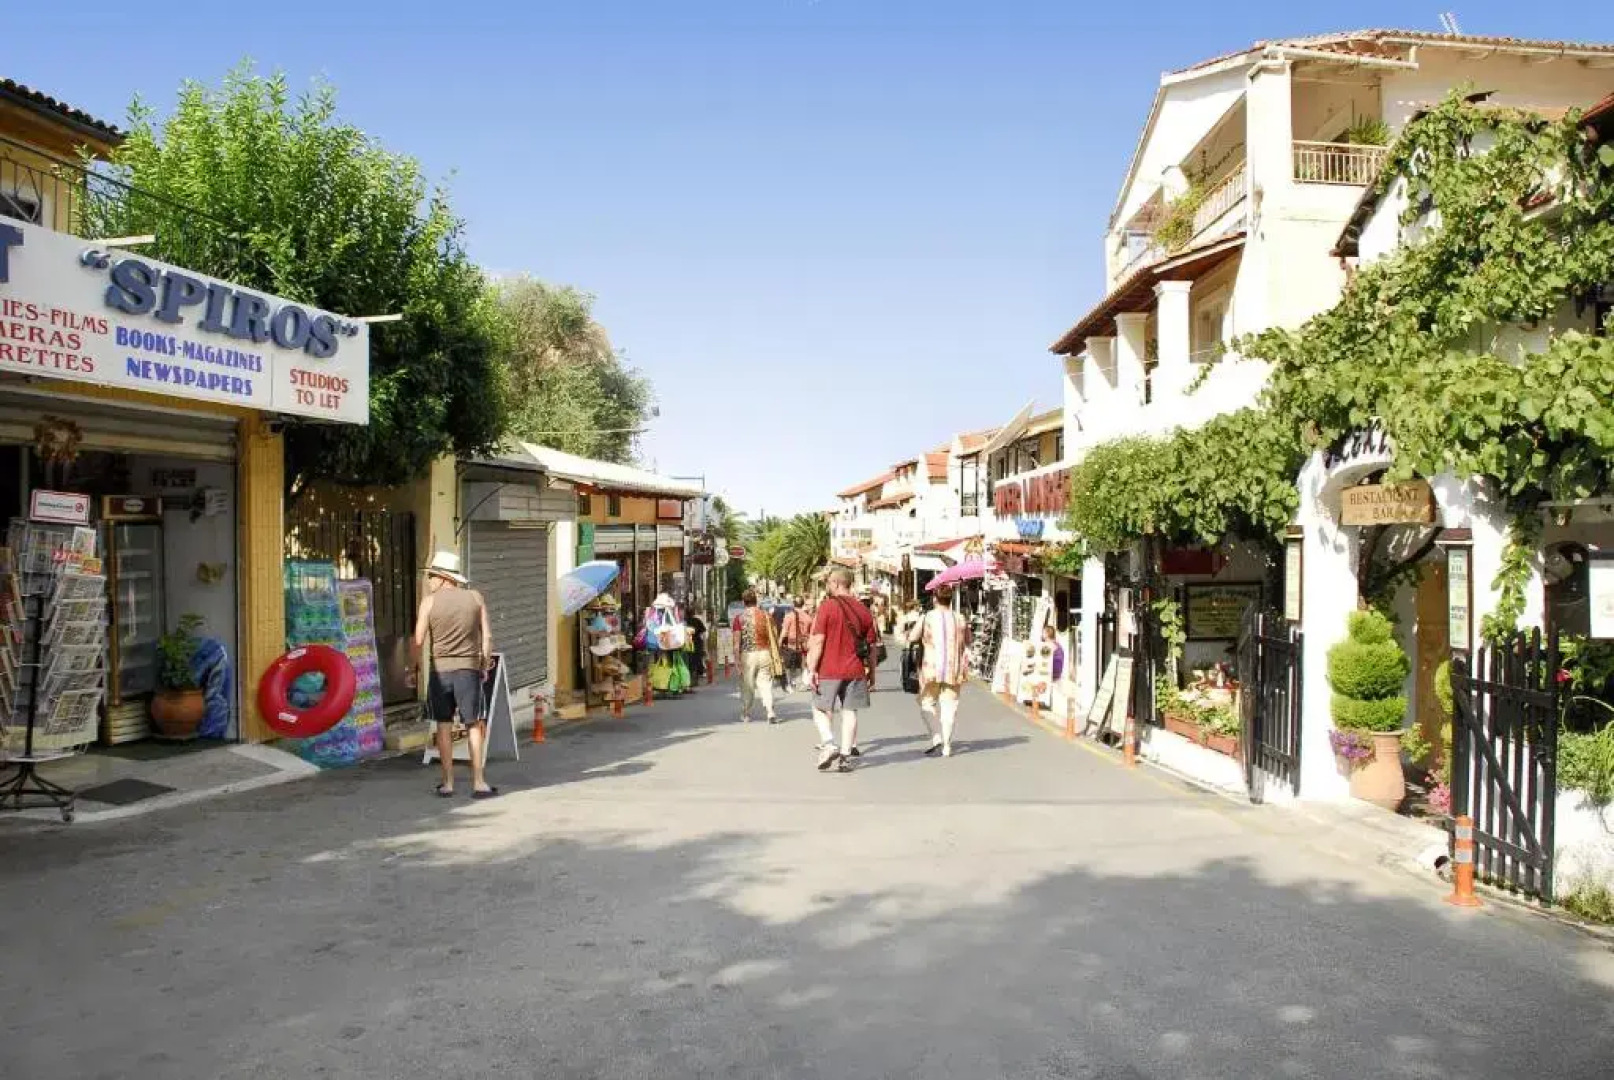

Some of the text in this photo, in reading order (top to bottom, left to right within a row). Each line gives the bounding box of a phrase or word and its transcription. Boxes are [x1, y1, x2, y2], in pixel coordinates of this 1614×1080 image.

[115, 325, 263, 373] BOOKS-MAGAZINES
[126, 357, 253, 397] NEWSPAPERS
[289, 368, 349, 394] STUDIOS
[295, 388, 341, 411] TO LET
[1373, 507, 1394, 520] BAR
